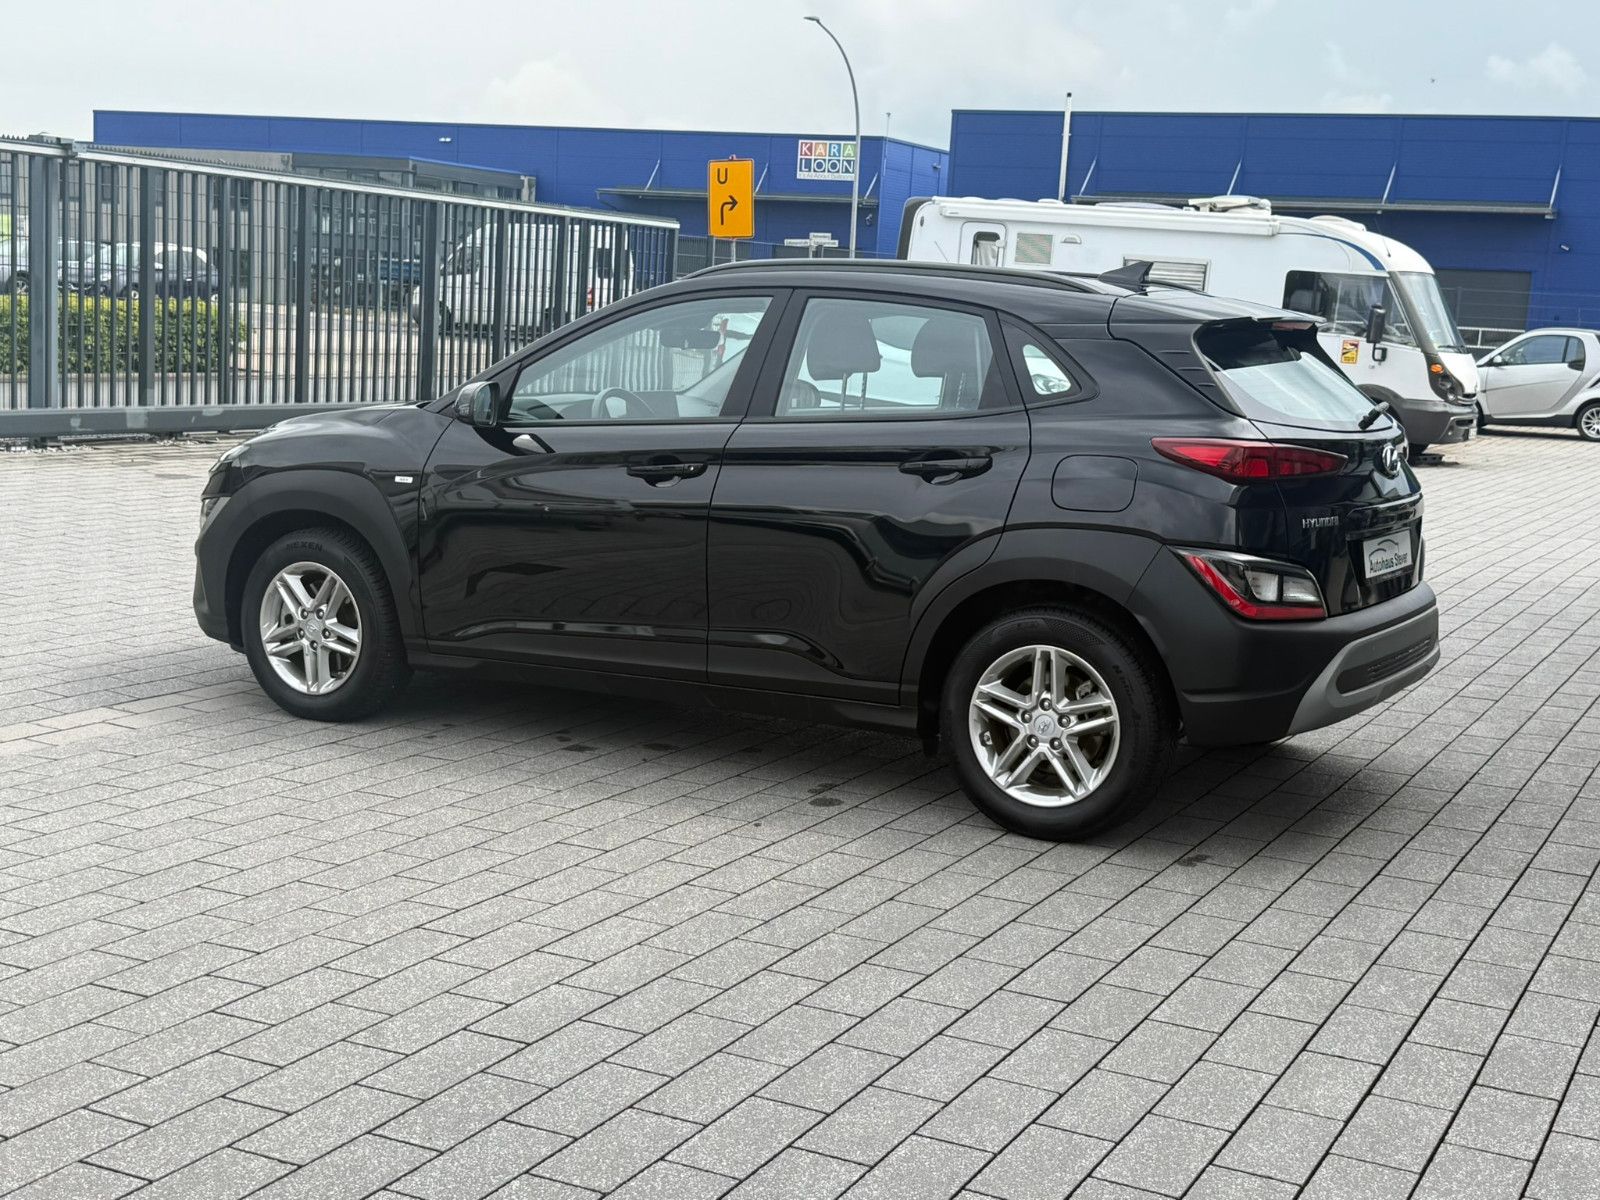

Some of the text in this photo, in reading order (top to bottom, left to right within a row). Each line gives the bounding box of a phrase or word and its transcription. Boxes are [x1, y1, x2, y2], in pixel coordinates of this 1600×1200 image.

[801, 143, 855, 157] KARA
[801, 159, 854, 173] LOON
[717, 168, 728, 184] U
[286, 541, 323, 551] NEXEN
[1369, 556, 1394, 574] Autohaus
